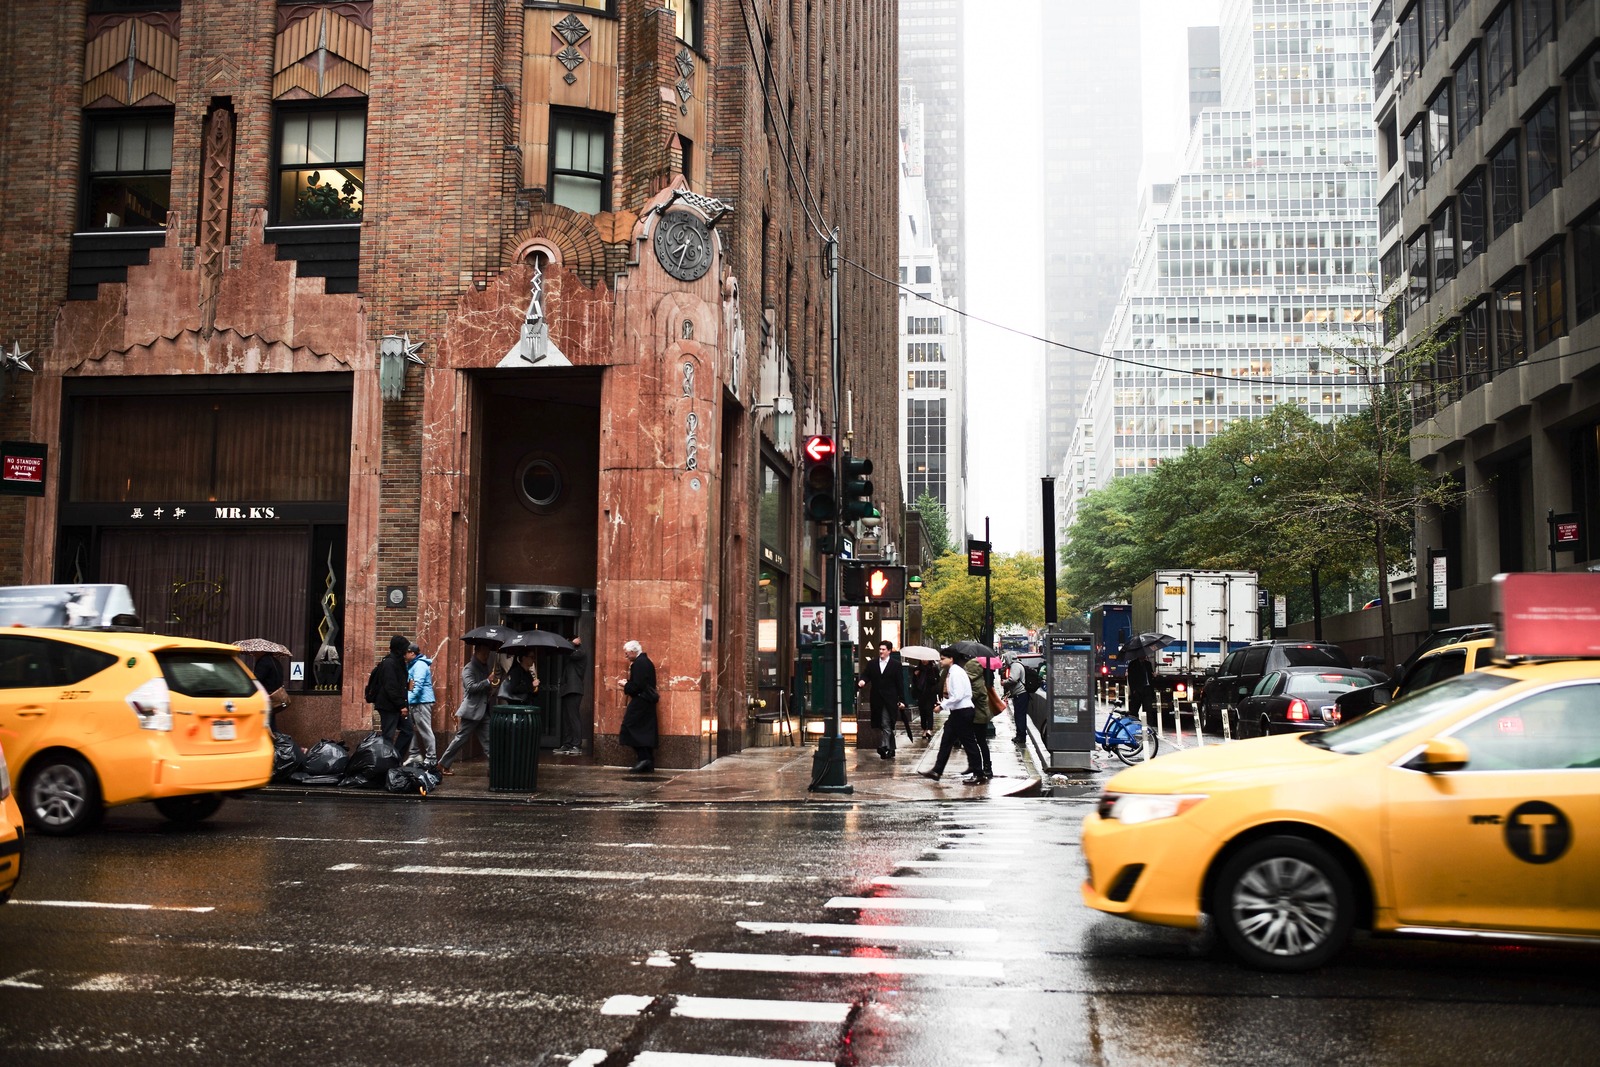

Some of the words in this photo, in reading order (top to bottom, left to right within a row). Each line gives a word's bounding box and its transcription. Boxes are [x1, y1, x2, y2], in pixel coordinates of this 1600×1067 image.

[680, 211, 690, 223] 12
[660, 220, 669, 231] 10
[657, 235, 663, 246] 9
[703, 230, 709, 241] 2
[660, 251, 666, 260] 8
[668, 263, 674, 272] 7
[681, 270, 687, 280] 6
[16, 458, 41, 466] STANDING
[10, 464, 37, 472] ANYTIME
[214, 507, 247, 519] MR.
[249, 506, 275, 519] K'S
[293, 664, 303, 676] A
